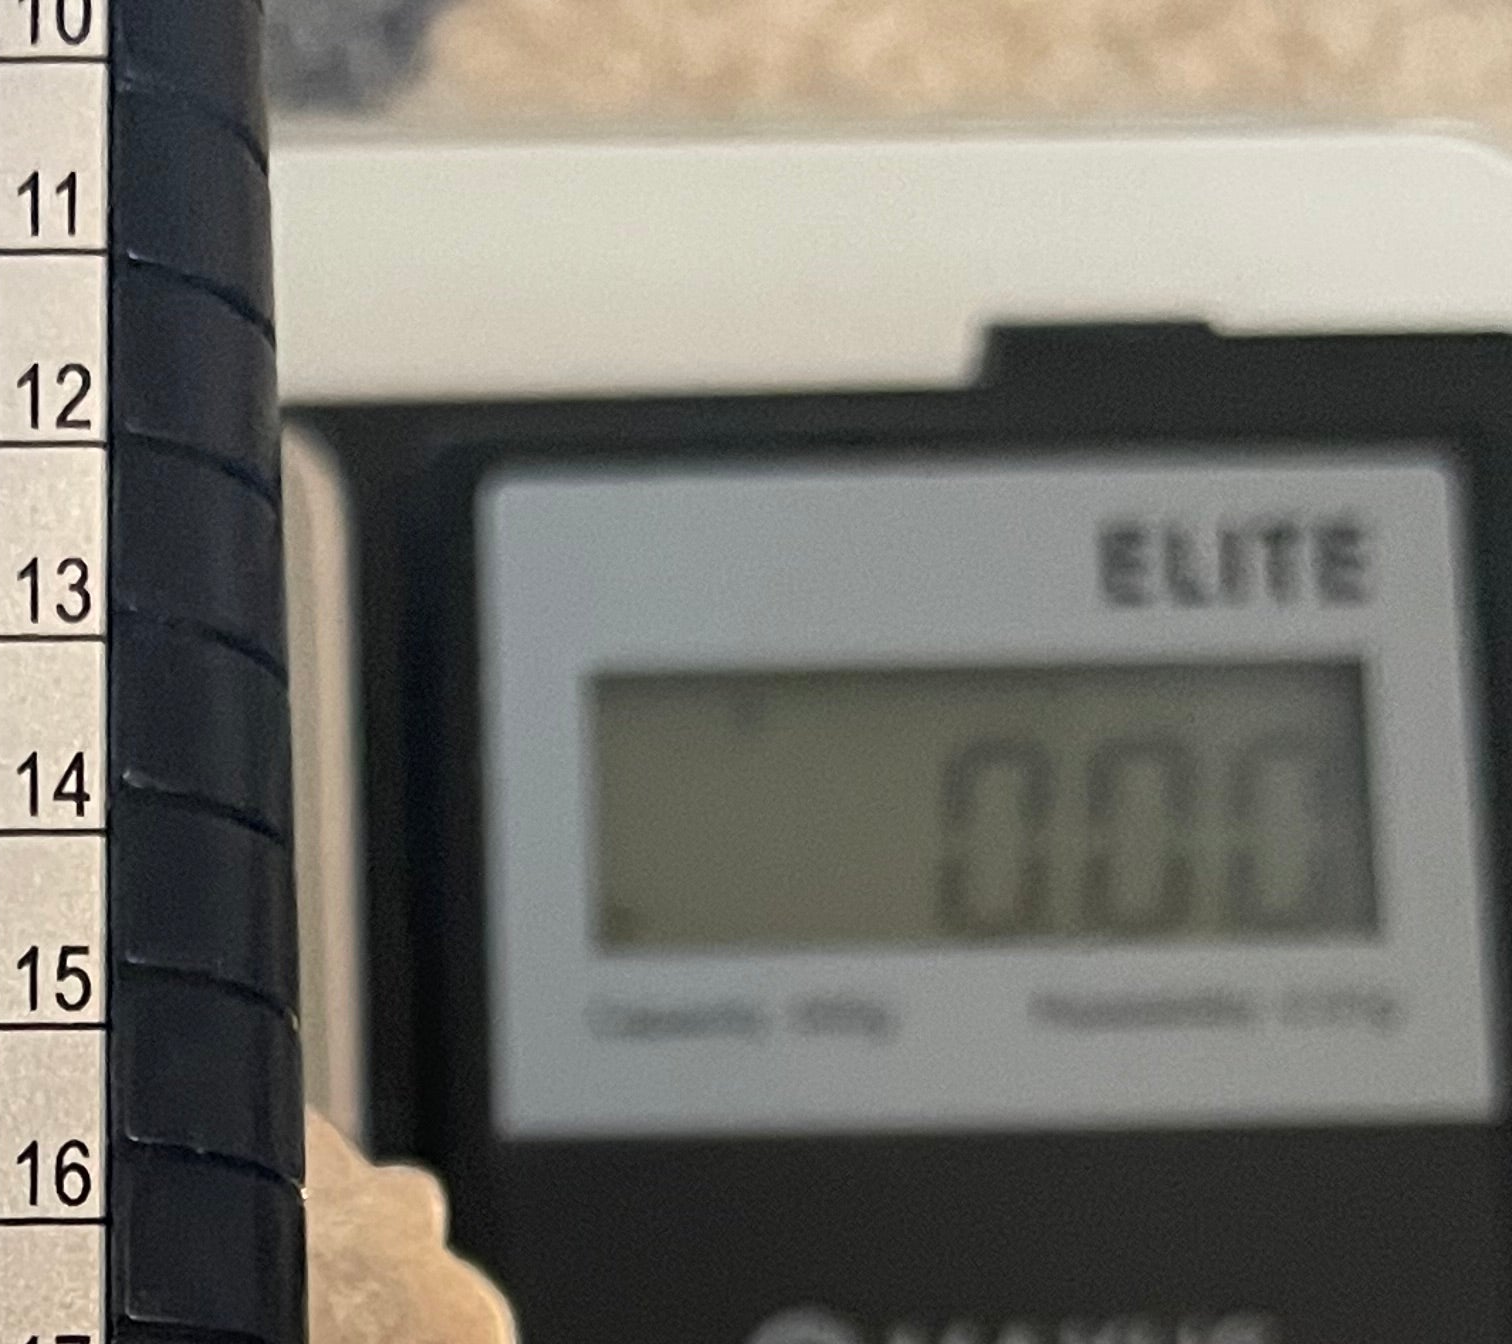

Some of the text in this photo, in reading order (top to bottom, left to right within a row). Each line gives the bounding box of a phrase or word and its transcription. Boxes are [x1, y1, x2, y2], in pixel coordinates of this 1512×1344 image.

[16, 0, 93, 47] 10
[16, 169, 78, 238] 11
[16, 361, 93, 431] 12
[16, 555, 93, 625] 13
[1097, 513, 1371, 608] ELITE
[16, 749, 93, 819] 14
[16, 944, 93, 1013] 15
[16, 1137, 93, 1208] 16
